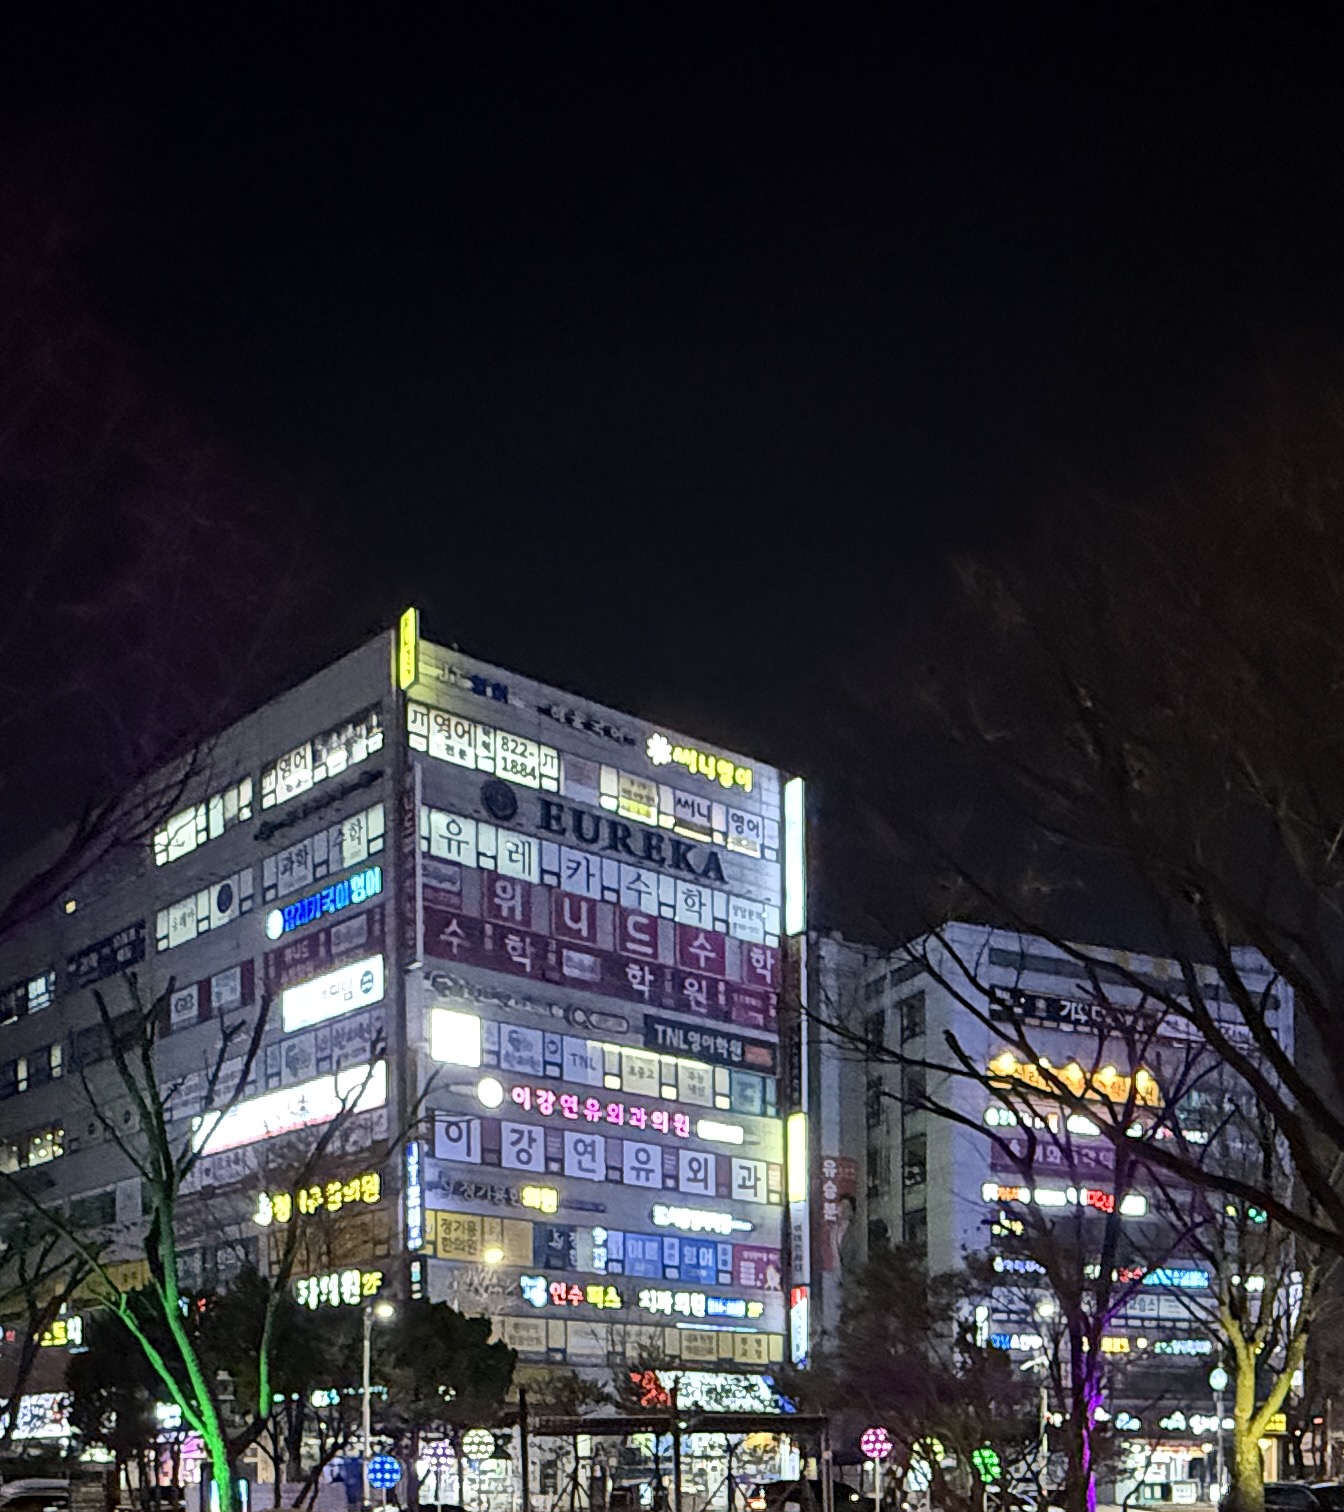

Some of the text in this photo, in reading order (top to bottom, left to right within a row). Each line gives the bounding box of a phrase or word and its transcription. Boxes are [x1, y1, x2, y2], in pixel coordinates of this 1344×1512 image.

[433, 713, 473, 747] 영어
[501, 757, 536, 781] 1884
[438, 819, 707, 924] 유레카수학
[537, 798, 729, 885] EUREKA
[494, 879, 775, 984] 위니드수학
[511, 1086, 691, 1139] 이강연유외과의원
[444, 1119, 764, 1198] 이강연유외과
